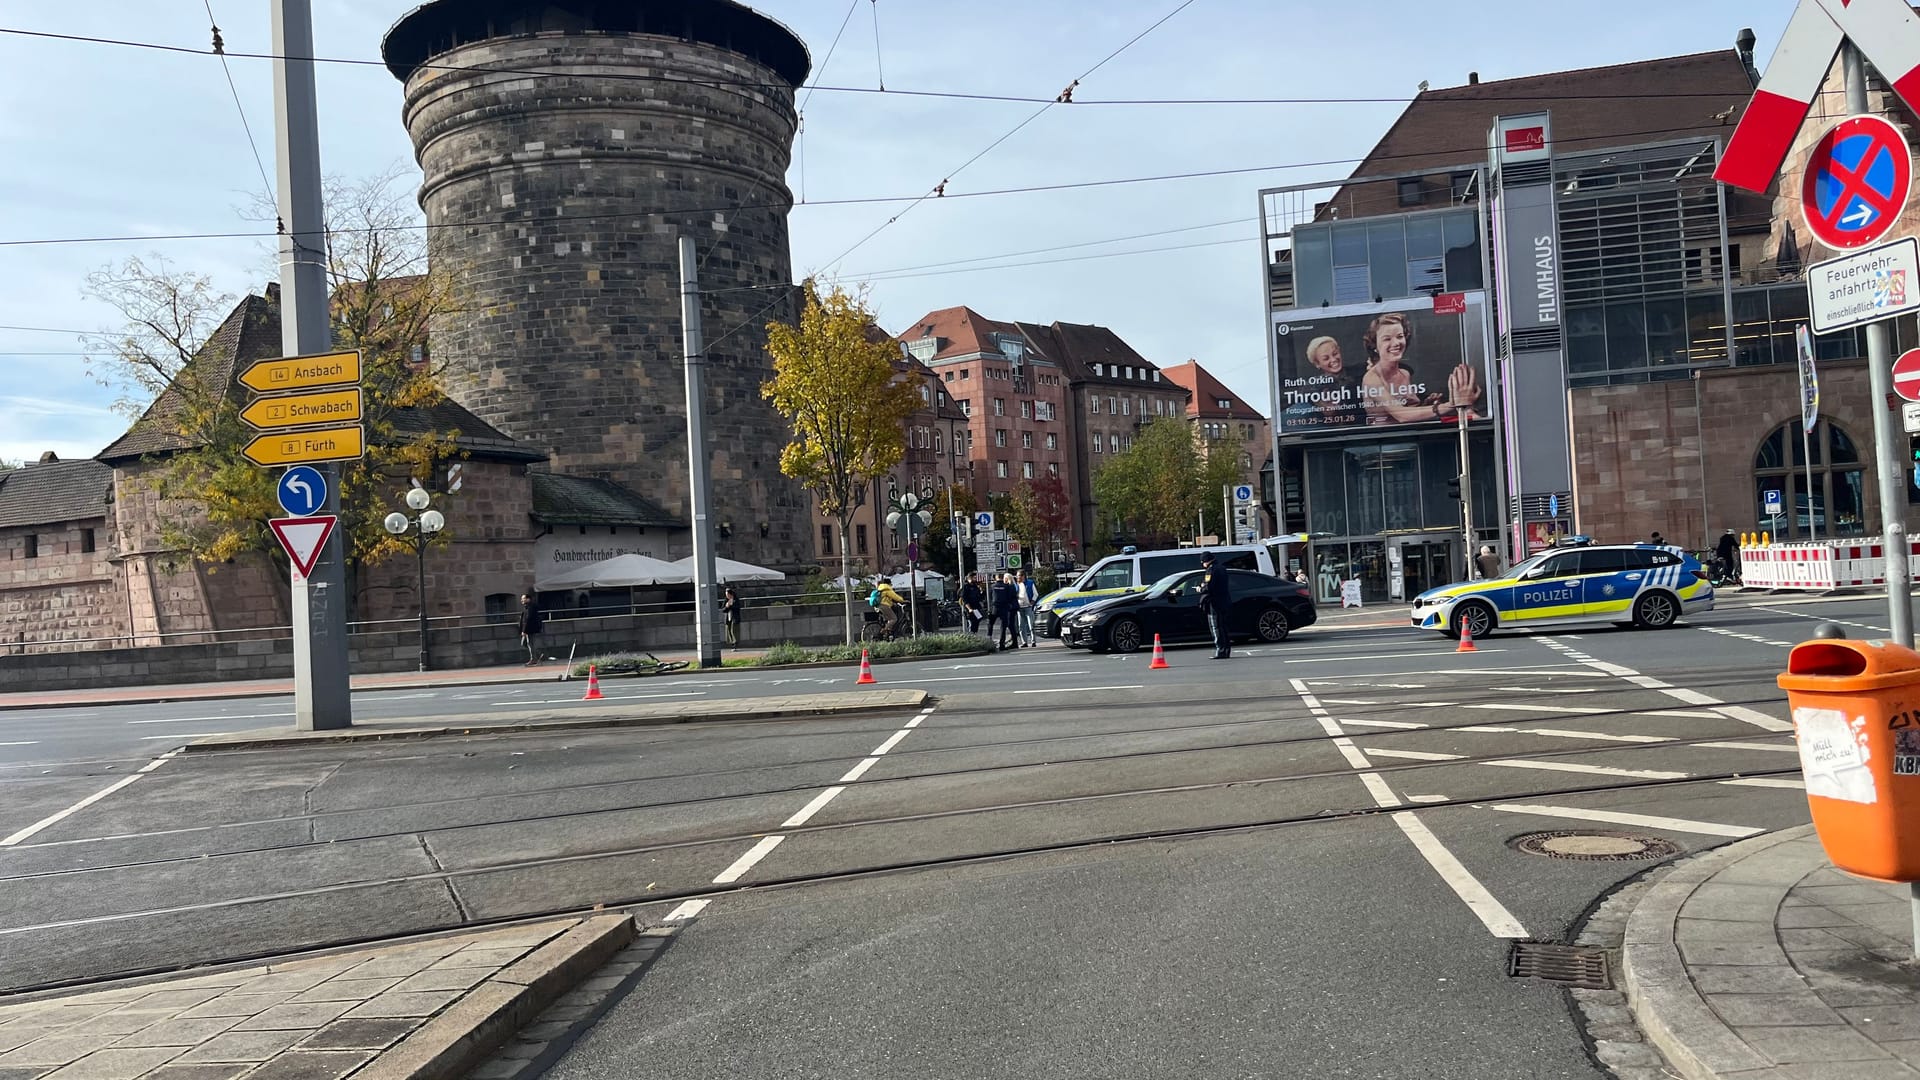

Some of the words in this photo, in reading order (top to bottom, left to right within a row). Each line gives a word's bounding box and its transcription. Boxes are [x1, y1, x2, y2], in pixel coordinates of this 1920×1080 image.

[1827, 256, 1898, 283] Feuerwehr-
[1534, 236, 1556, 322] FILMHAUS
[1829, 278, 1877, 300] anfahrtz
[1826, 300, 1875, 321] einschließlich
[294, 363, 343, 379] Ansbach
[1284, 377, 1306, 388] Ruth
[1308, 375, 1334, 386] Orkin
[1284, 386, 1351, 404] Through
[1356, 385, 1385, 399] Her
[1390, 382, 1426, 396] Lens
[273, 407, 280, 417] 2
[290, 400, 353, 416] Schwabach
[1286, 405, 1325, 416] Fotografien
[1326, 403, 1357, 412] zwischen
[305, 440, 335, 452] Fürth
[1767, 492, 1776, 503] P
[1011, 556, 1019, 567] S
[1523, 588, 1574, 604] POLIZEI
[1815, 749, 1837, 762] mich
